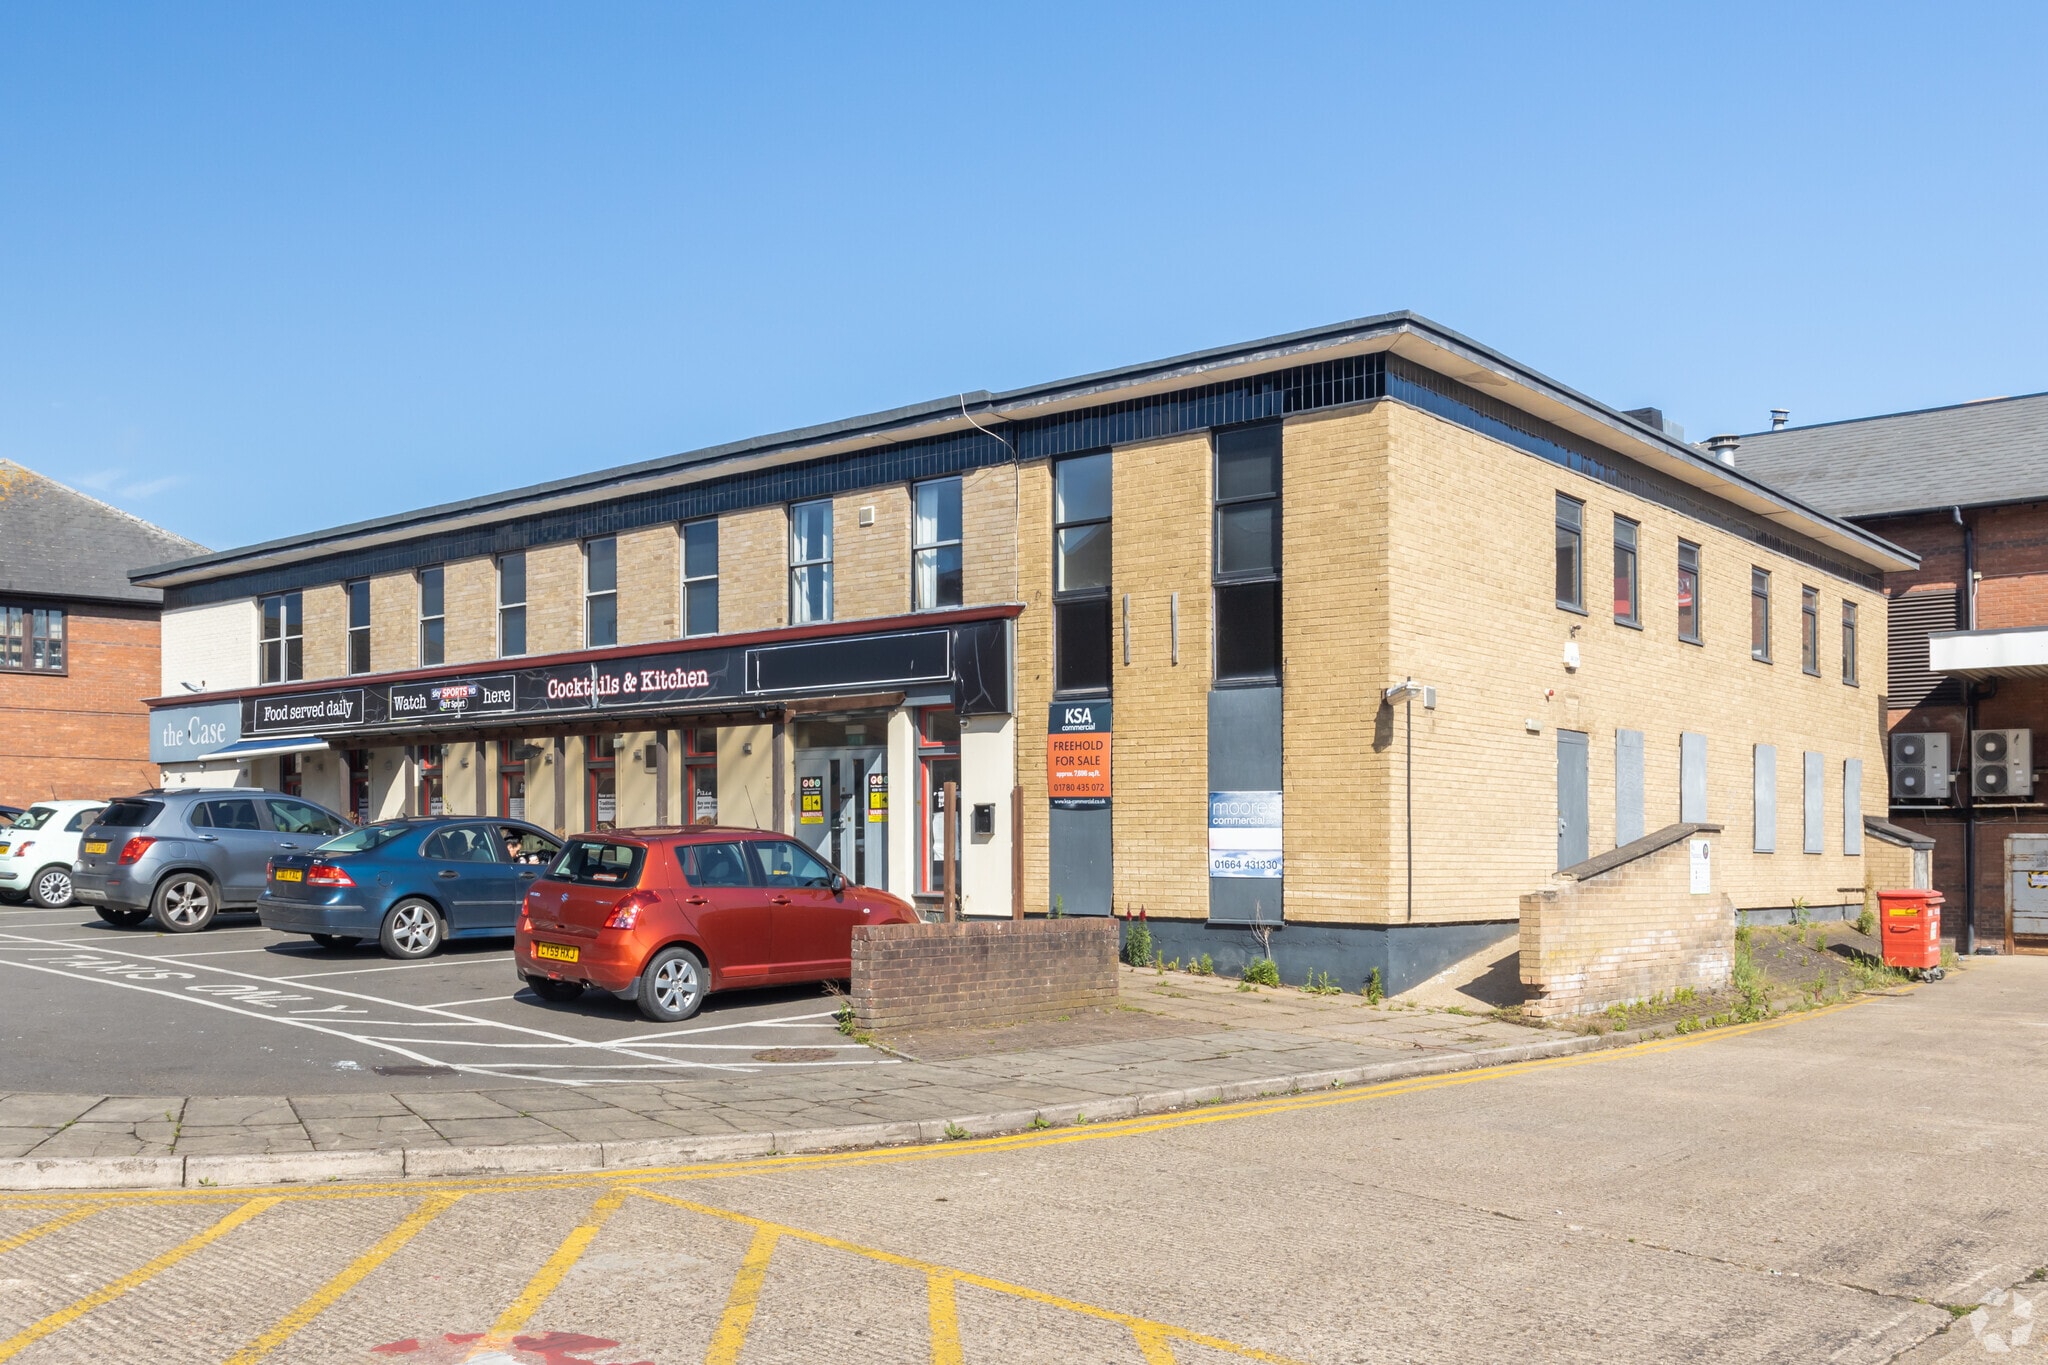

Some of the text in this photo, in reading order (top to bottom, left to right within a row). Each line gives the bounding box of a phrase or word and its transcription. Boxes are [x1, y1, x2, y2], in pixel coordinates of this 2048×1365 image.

[548, 667, 709, 698] Cocktails & Kitchen
[393, 688, 511, 711] Watch here
[432, 687, 476, 699] sky SPORTS HD
[264, 699, 354, 722] Food served daily
[1065, 707, 1092, 724] KSA
[163, 716, 226, 747] the Case
[1062, 723, 1096, 731] commercial
[1053, 740, 1104, 752] FREEHOLD
[1055, 755, 1100, 766] FOR SALE
[1076, 783, 1090, 791] 435
[1091, 783, 1105, 791] 072
[1212, 802, 1277, 815] moores
[1214, 860, 1278, 870] 01664 431330
[541, 944, 575, 959] CY59 HXJ
[27, 954, 369, 1014] TAXIS ONLY
